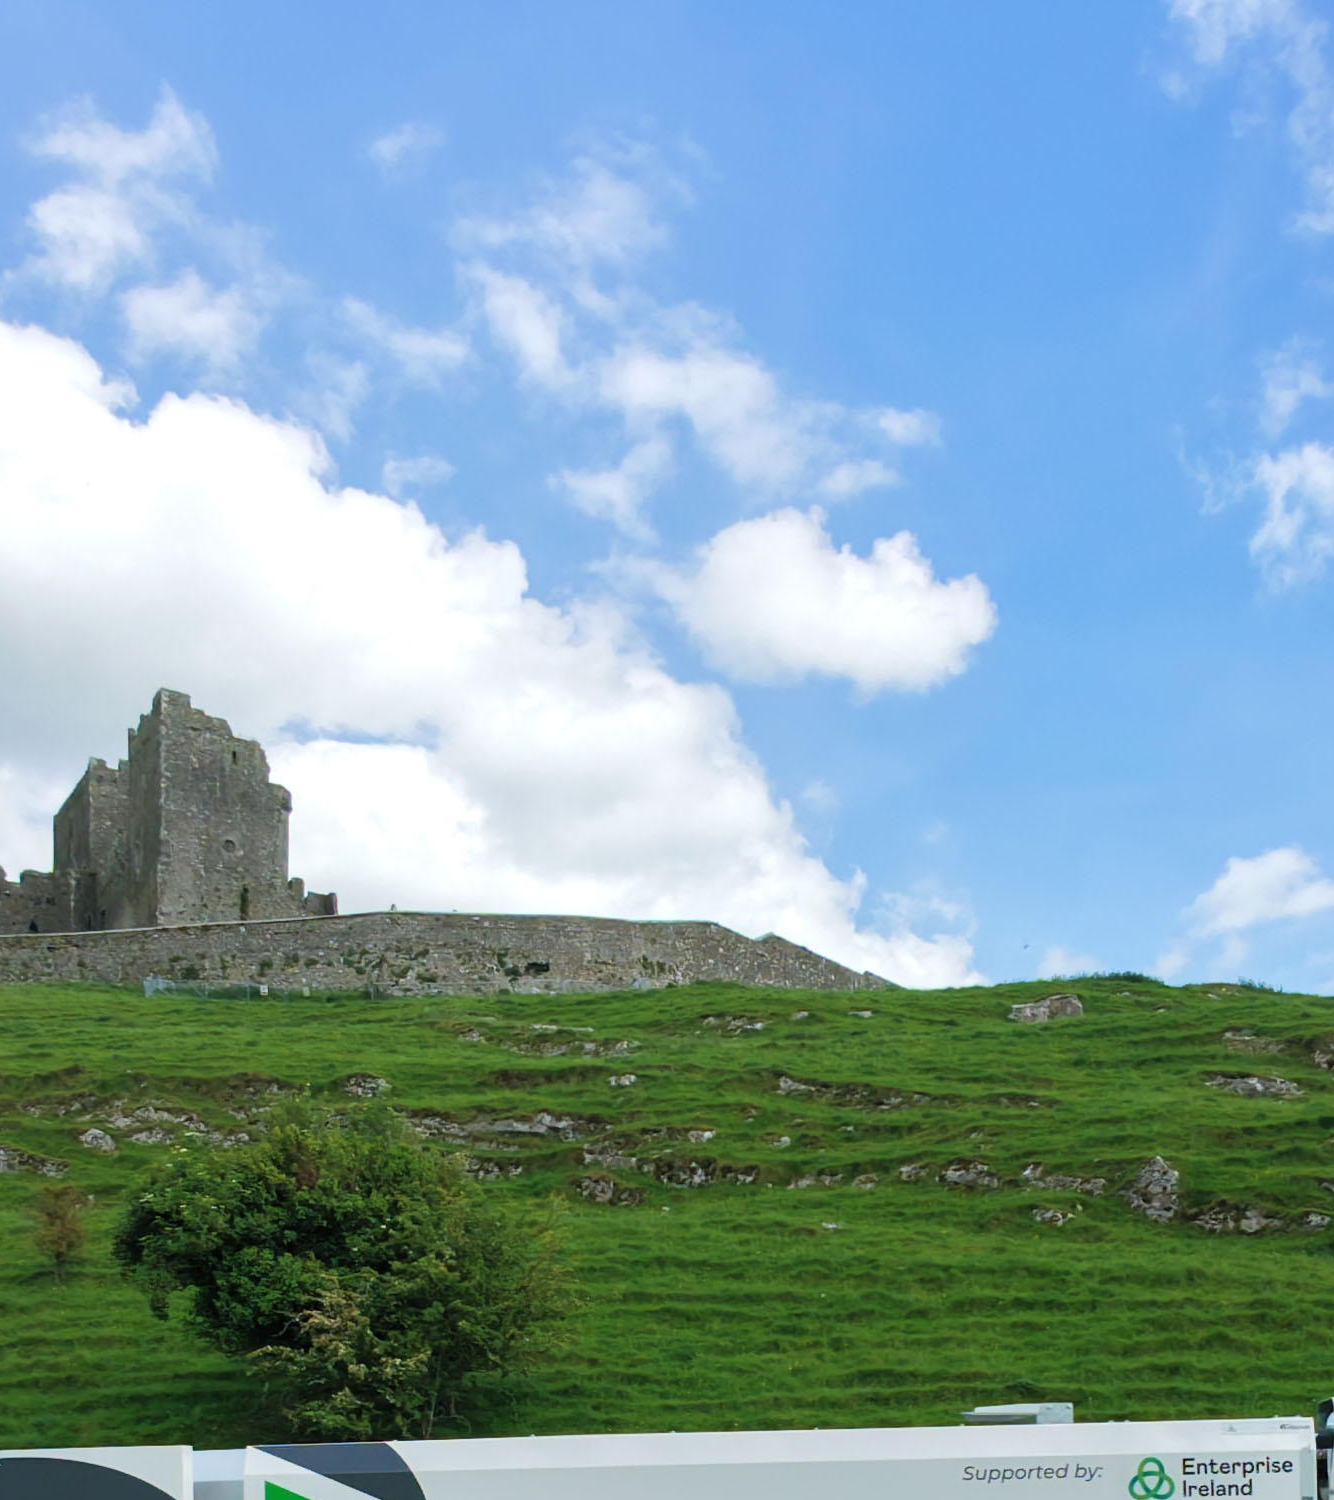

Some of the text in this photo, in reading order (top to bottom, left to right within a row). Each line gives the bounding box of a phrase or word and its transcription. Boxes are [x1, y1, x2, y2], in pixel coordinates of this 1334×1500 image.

[962, 1464, 1103, 1483] Supported by:
[1182, 1456, 1294, 1478] Enterprise
[1182, 1479, 1253, 1498] Ireland
